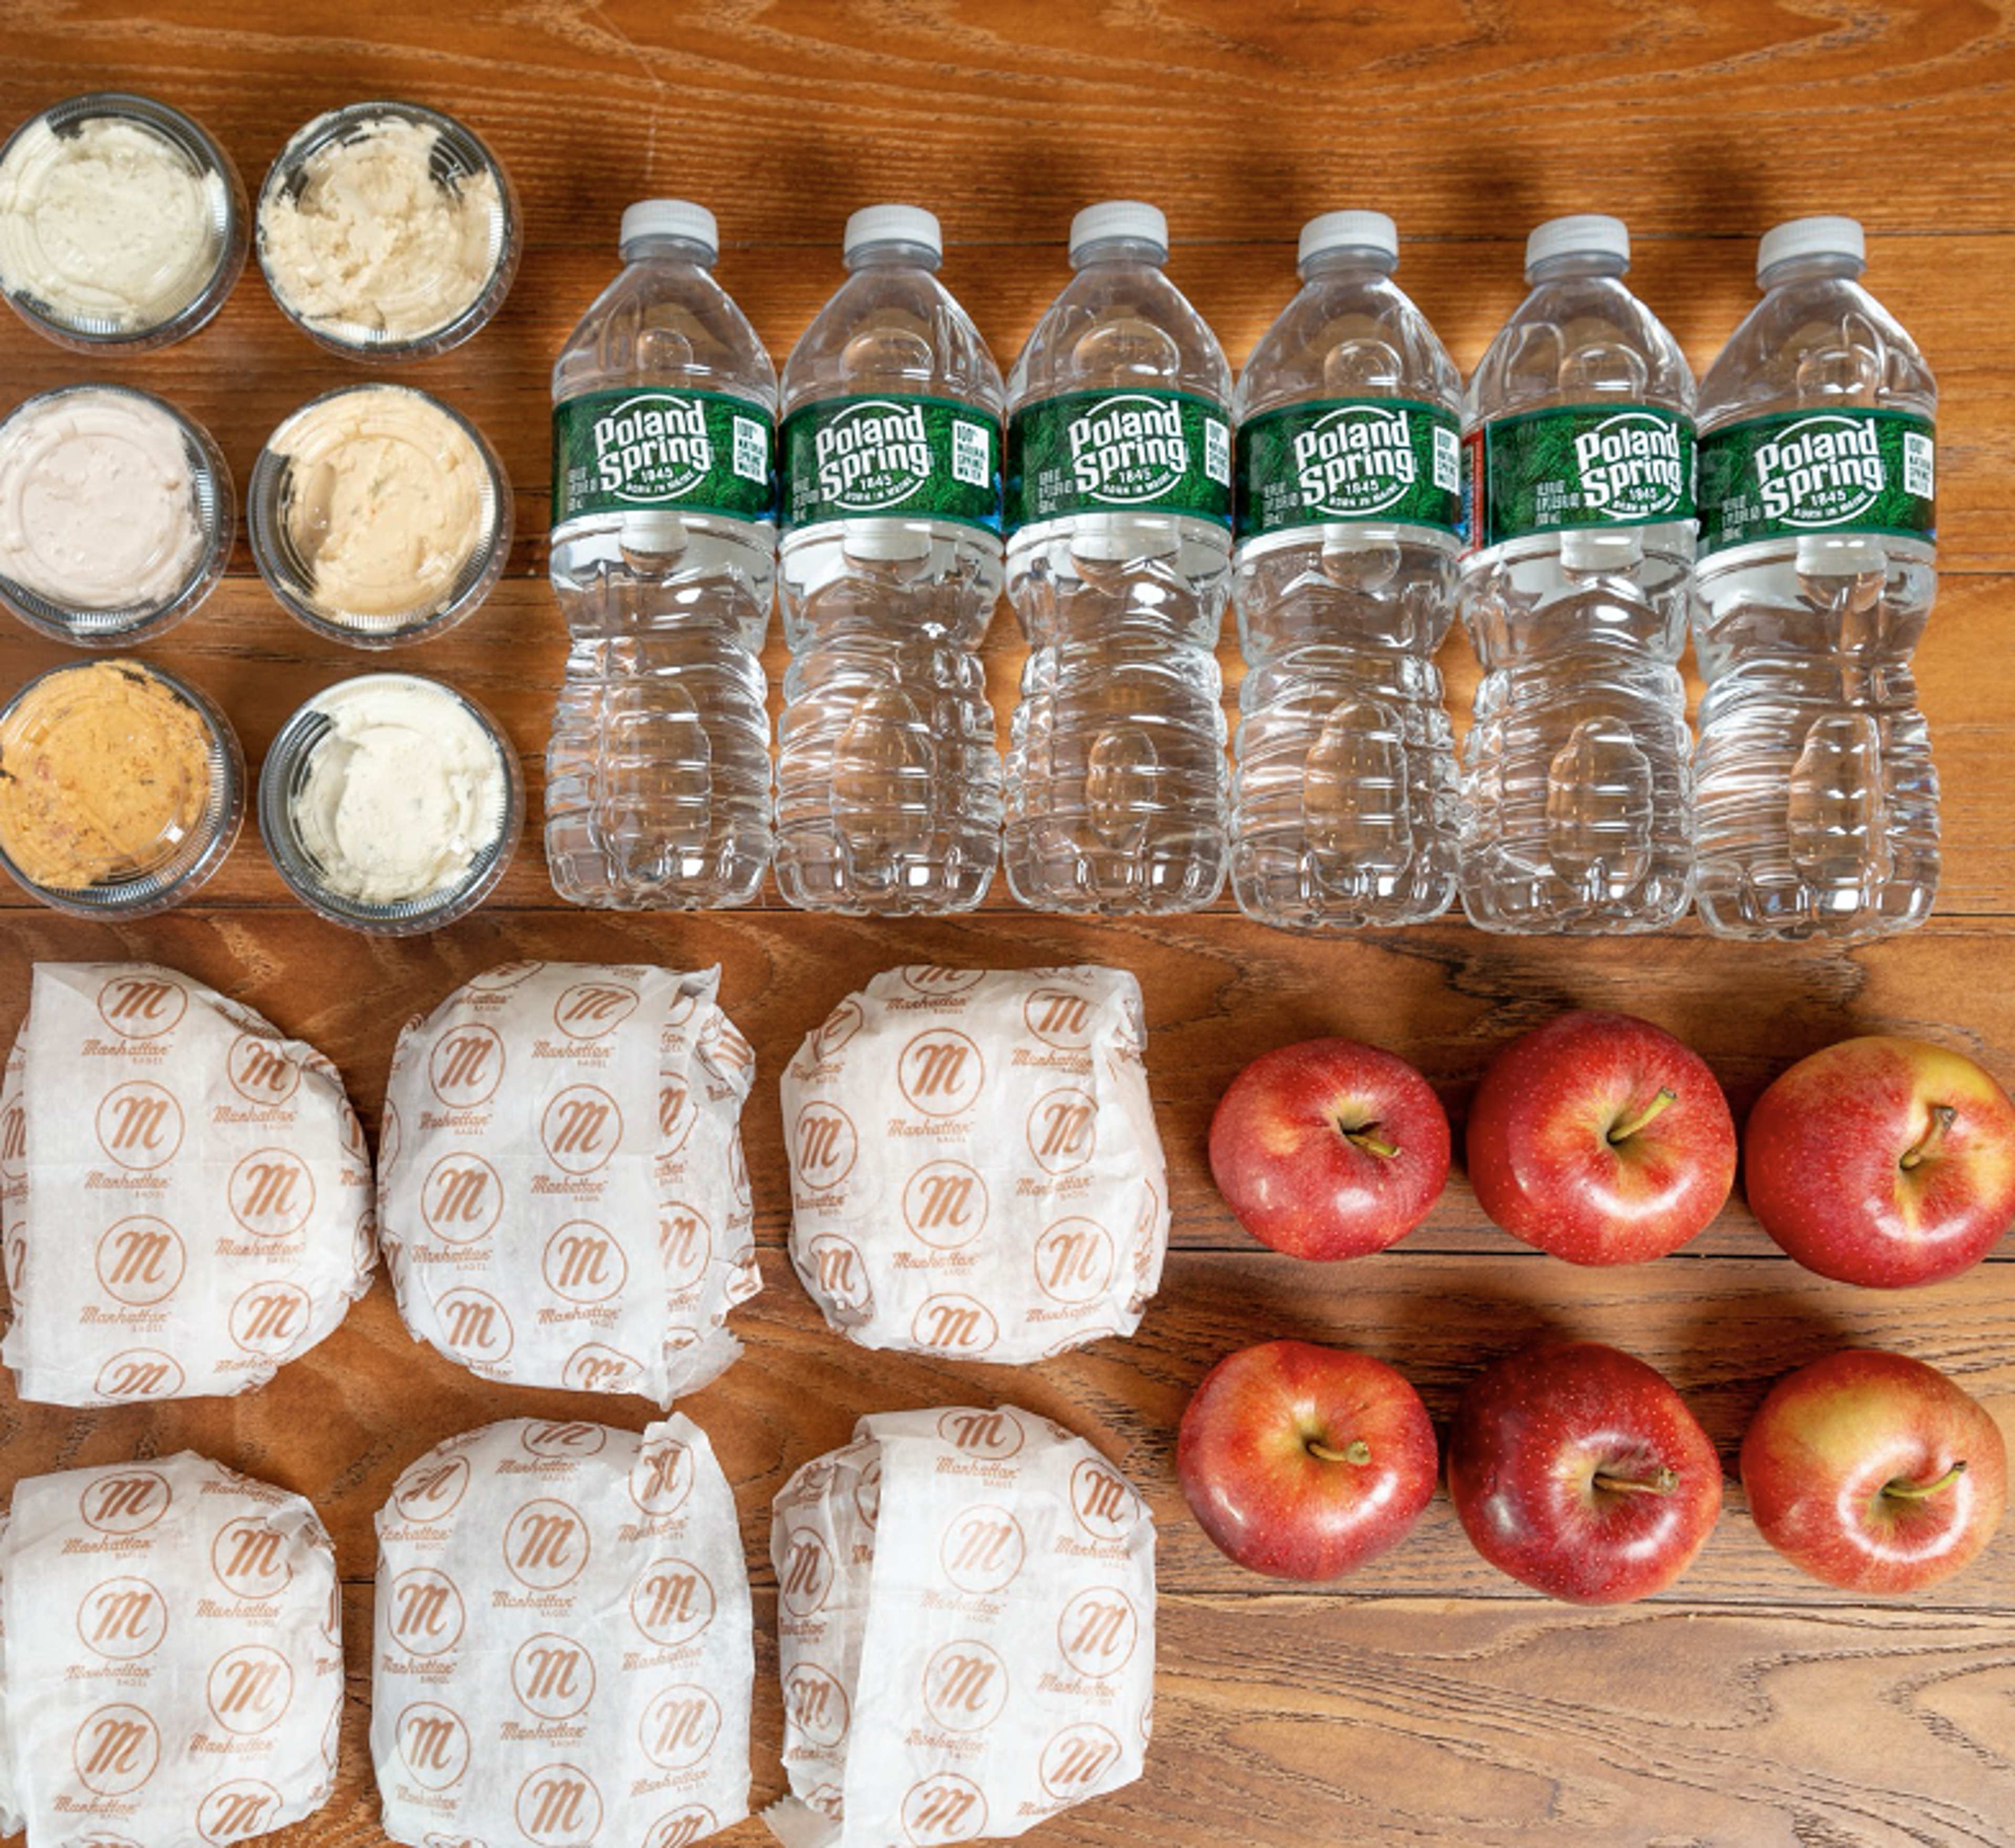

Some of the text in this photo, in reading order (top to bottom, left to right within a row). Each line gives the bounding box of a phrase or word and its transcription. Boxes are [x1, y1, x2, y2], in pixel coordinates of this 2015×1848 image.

[593, 400, 708, 456] Poland
[815, 405, 927, 467] Poland
[1067, 400, 1183, 459] Poland
[1293, 410, 1410, 471] Poland
[1574, 422, 1680, 472] Poland
[1754, 418, 1880, 482] Poland
[597, 436, 711, 491] Spring
[819, 442, 930, 502] Spring
[1073, 437, 1187, 492] Spring
[1298, 447, 1415, 506] Spring
[1579, 455, 1682, 507] Spring
[1759, 455, 1884, 519] Spring
[887, 997, 968, 1011] Manhattan
[81, 1039, 171, 1057] Manhattan
[531, 1042, 611, 1059] Manhattan
[887, 1119, 971, 1137] Manhattan
[84, 1171, 171, 1189] Manhattan
[531, 1176, 606, 1193] Manhattan
[215, 1237, 304, 1256] Manhattan
[412, 1245, 491, 1262] Manhattan
[80, 1306, 171, 1323] Manhattan
[538, 1306, 619, 1324] Manhattan
[496, 1459, 577, 1474] Manhattan
[936, 1457, 1017, 1478] Manhattan
[61, 1538, 151, 1555] Manhattan
[492, 1591, 574, 1607] Manhattan
[195, 1600, 280, 1618] Manhattan
[622, 1648, 702, 1670] Manhattan
[501, 1722, 586, 1741] Manhattan
[190, 1734, 273, 1754] Manhattan
[632, 1770, 707, 1797] Manhattan
[55, 1797, 137, 1814] Manhattan
